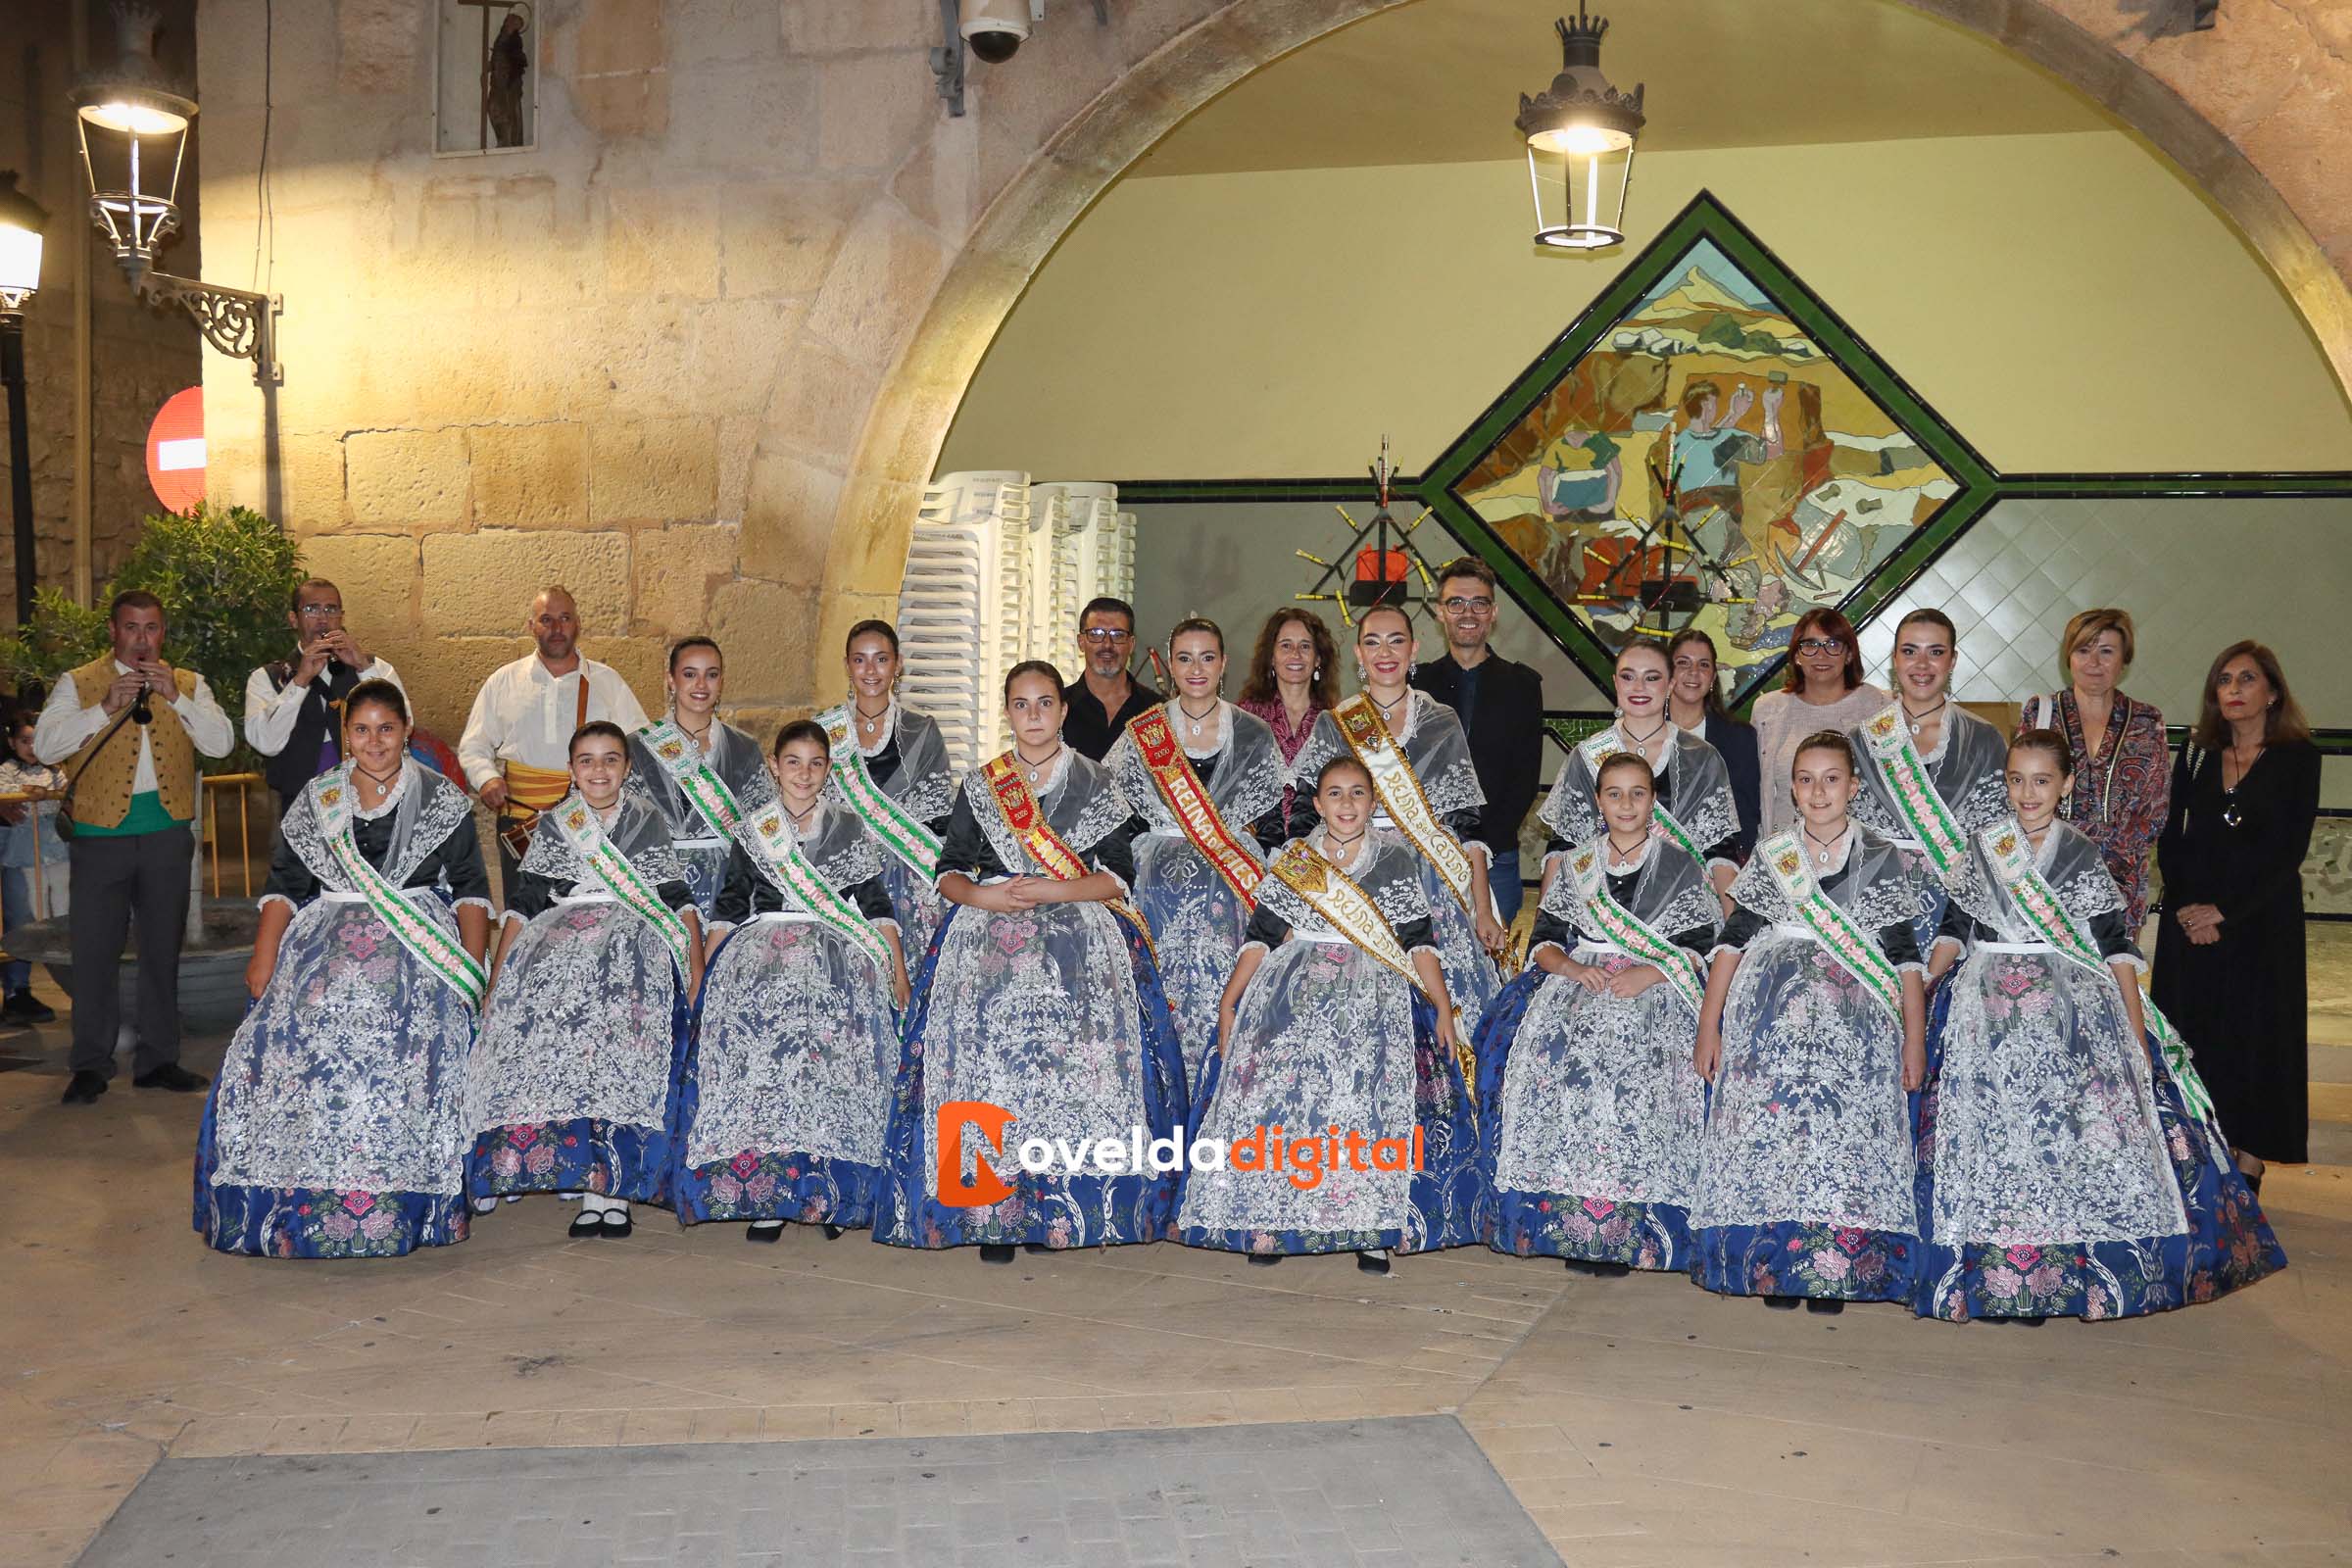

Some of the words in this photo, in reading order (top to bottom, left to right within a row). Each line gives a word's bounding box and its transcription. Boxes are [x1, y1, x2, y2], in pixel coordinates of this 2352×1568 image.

[697, 782, 735, 831] DAM
[1168, 776, 1214, 840] REINA
[1218, 849, 1259, 890] FIES
[399, 914, 463, 975] HONOR
